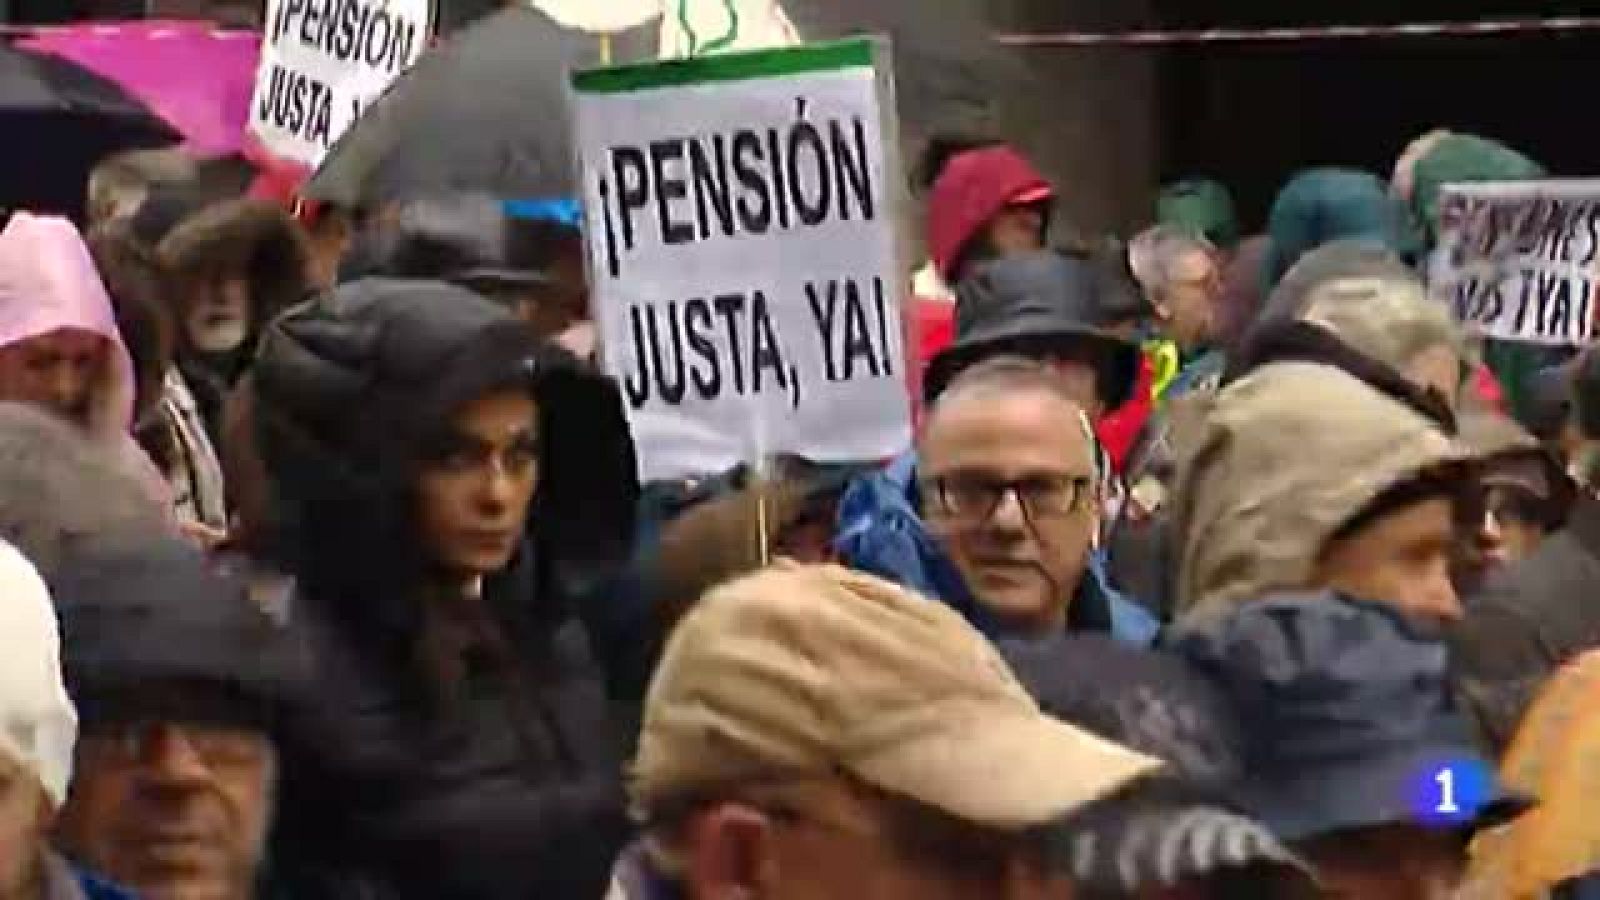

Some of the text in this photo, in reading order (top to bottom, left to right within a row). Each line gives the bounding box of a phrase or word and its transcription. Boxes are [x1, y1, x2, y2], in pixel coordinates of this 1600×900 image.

[600, 96, 875, 278] ¡PENSIÓN
[624, 277, 893, 411] JUSTA, YA!
